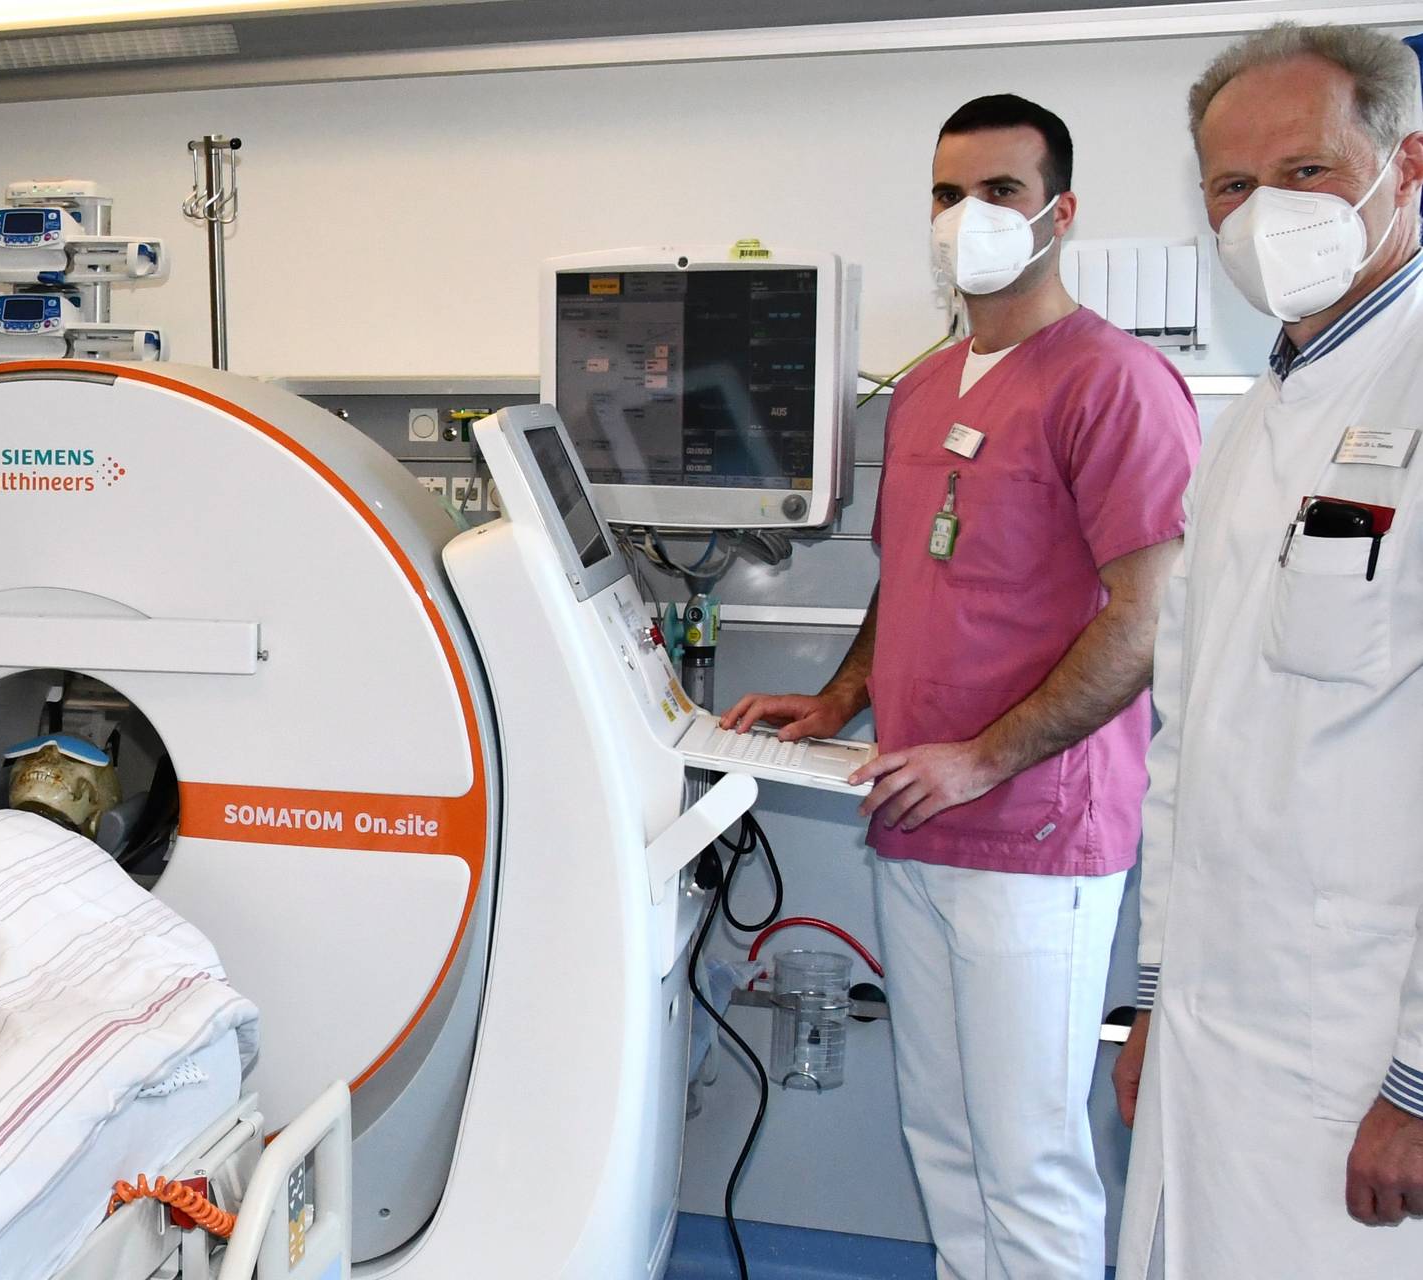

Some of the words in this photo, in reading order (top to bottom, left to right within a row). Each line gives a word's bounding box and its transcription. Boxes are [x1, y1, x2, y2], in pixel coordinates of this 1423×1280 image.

[1, 448, 95, 466] SIEMENS
[224, 803, 343, 832] SOMATOM
[354, 812, 439, 838] On.site
